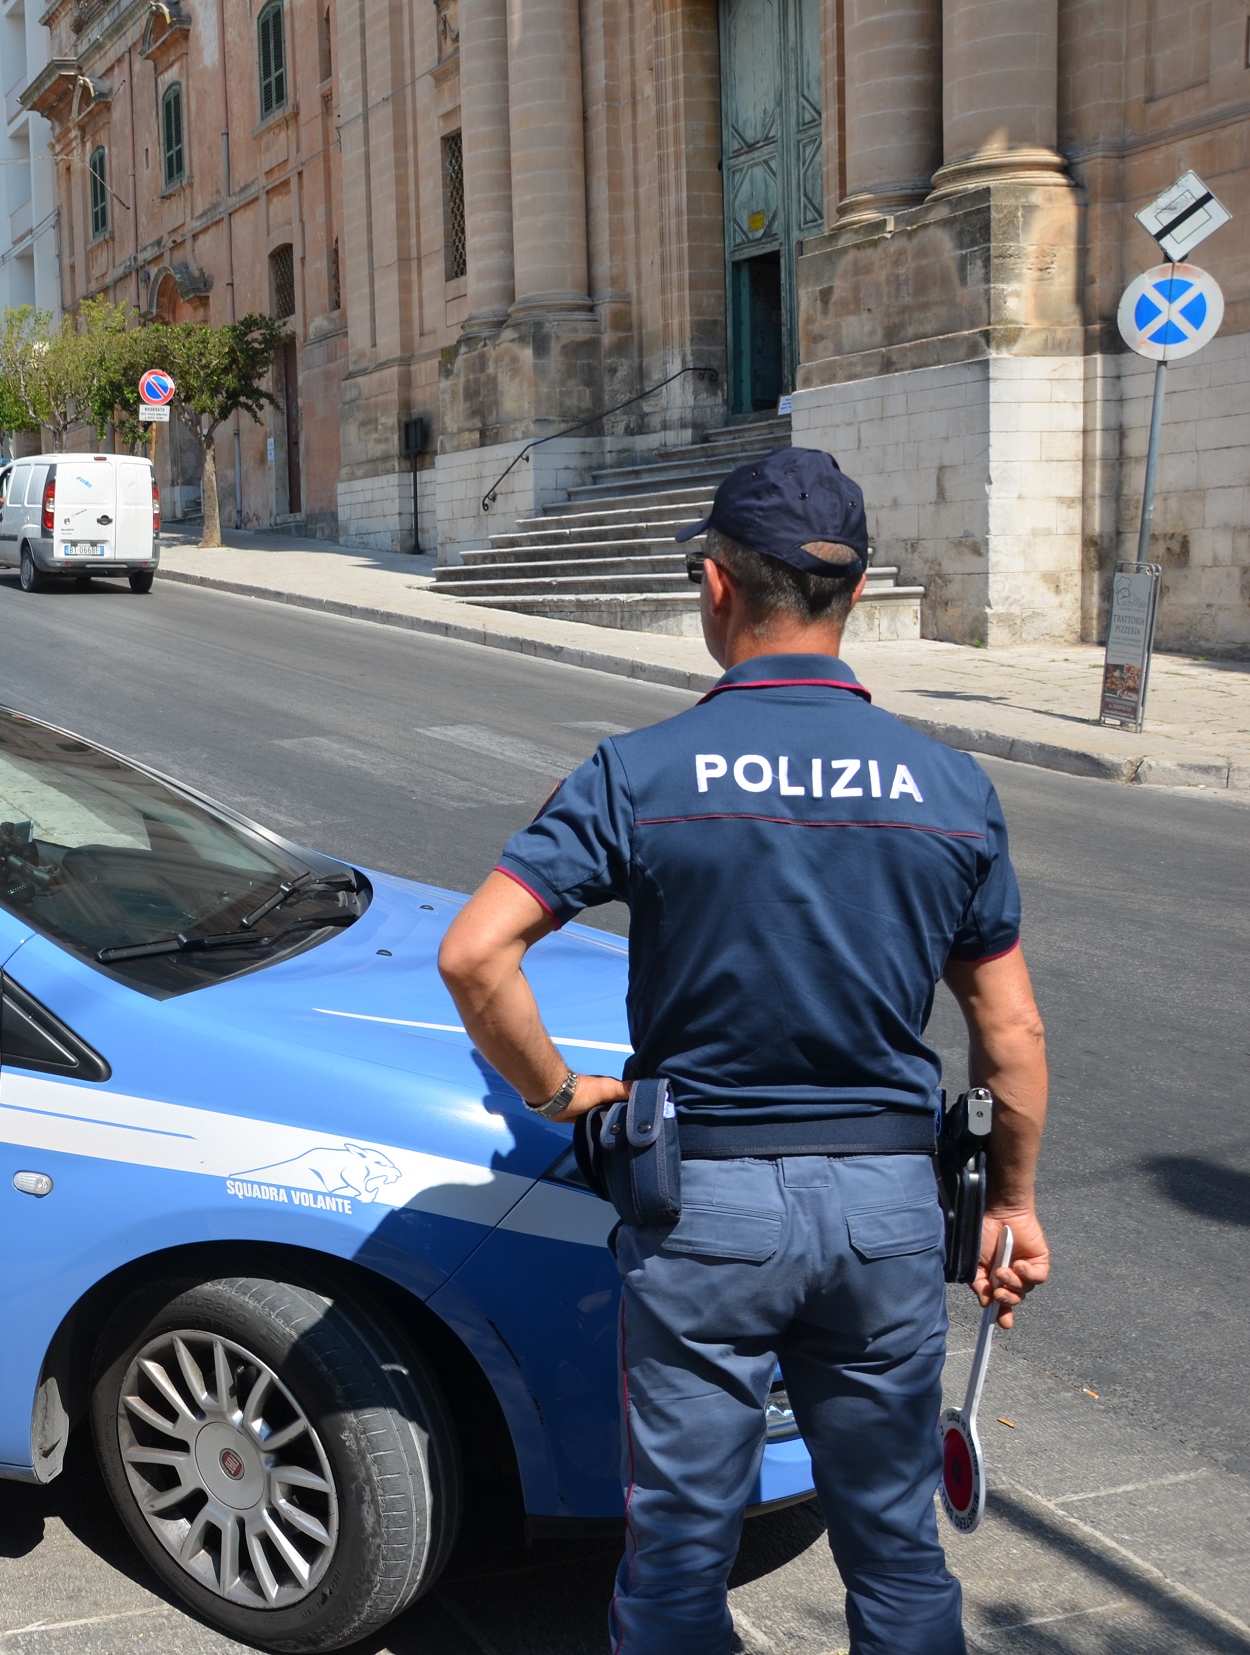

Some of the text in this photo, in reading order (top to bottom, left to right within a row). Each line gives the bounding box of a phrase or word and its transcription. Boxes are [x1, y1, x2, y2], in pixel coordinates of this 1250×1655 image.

[1112, 614, 1145, 626] TRATTORIA
[1115, 625, 1141, 636] PIZZERIA
[695, 754, 924, 803] POLIZIA
[225, 1180, 353, 1215] SQUADRA VOLANTE
